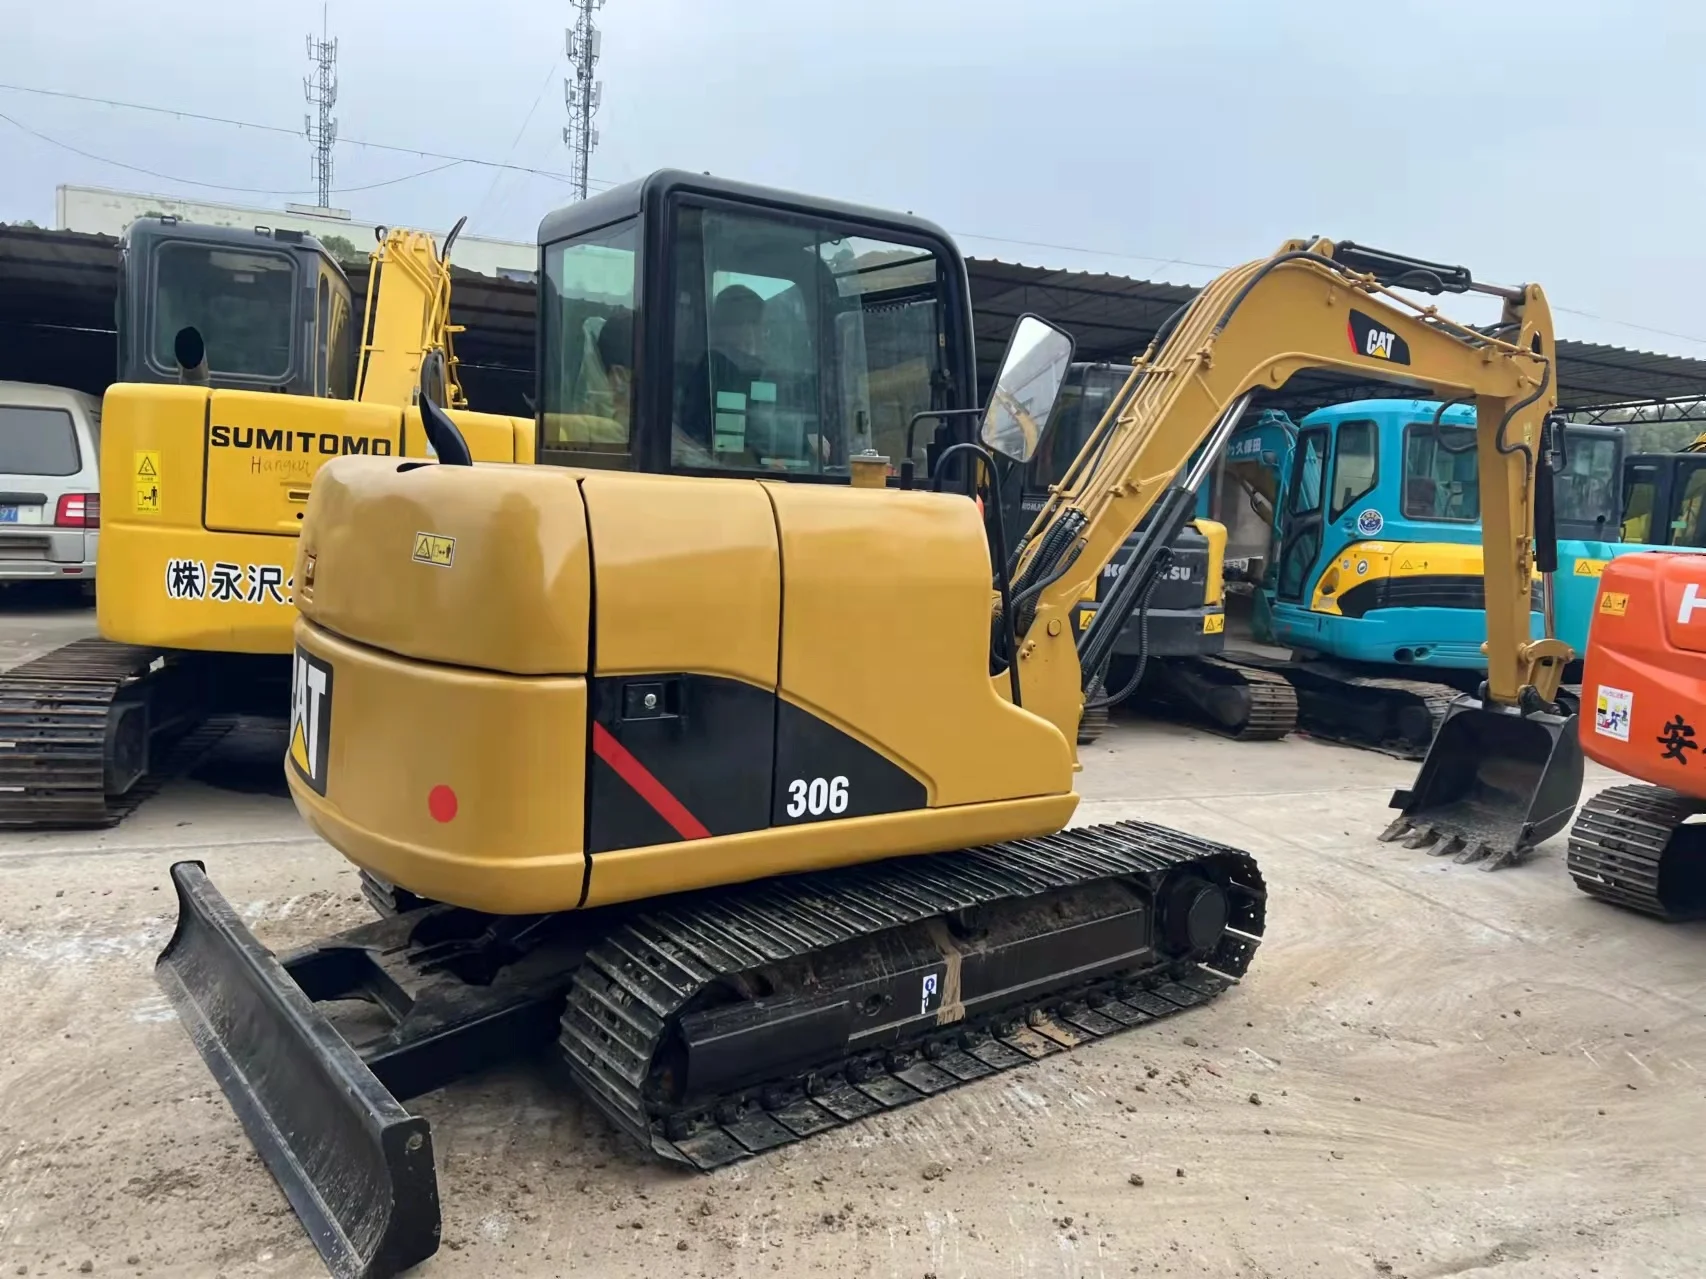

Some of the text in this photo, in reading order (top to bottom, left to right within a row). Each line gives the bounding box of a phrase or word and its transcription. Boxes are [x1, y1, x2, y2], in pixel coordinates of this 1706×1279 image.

[1367, 329, 1395, 359] CAT
[211, 426, 391, 456] SUMITOMO
[167, 560, 293, 602] (株)永沢
[1656, 714, 1706, 765] 安
[786, 775, 849, 818] 306
